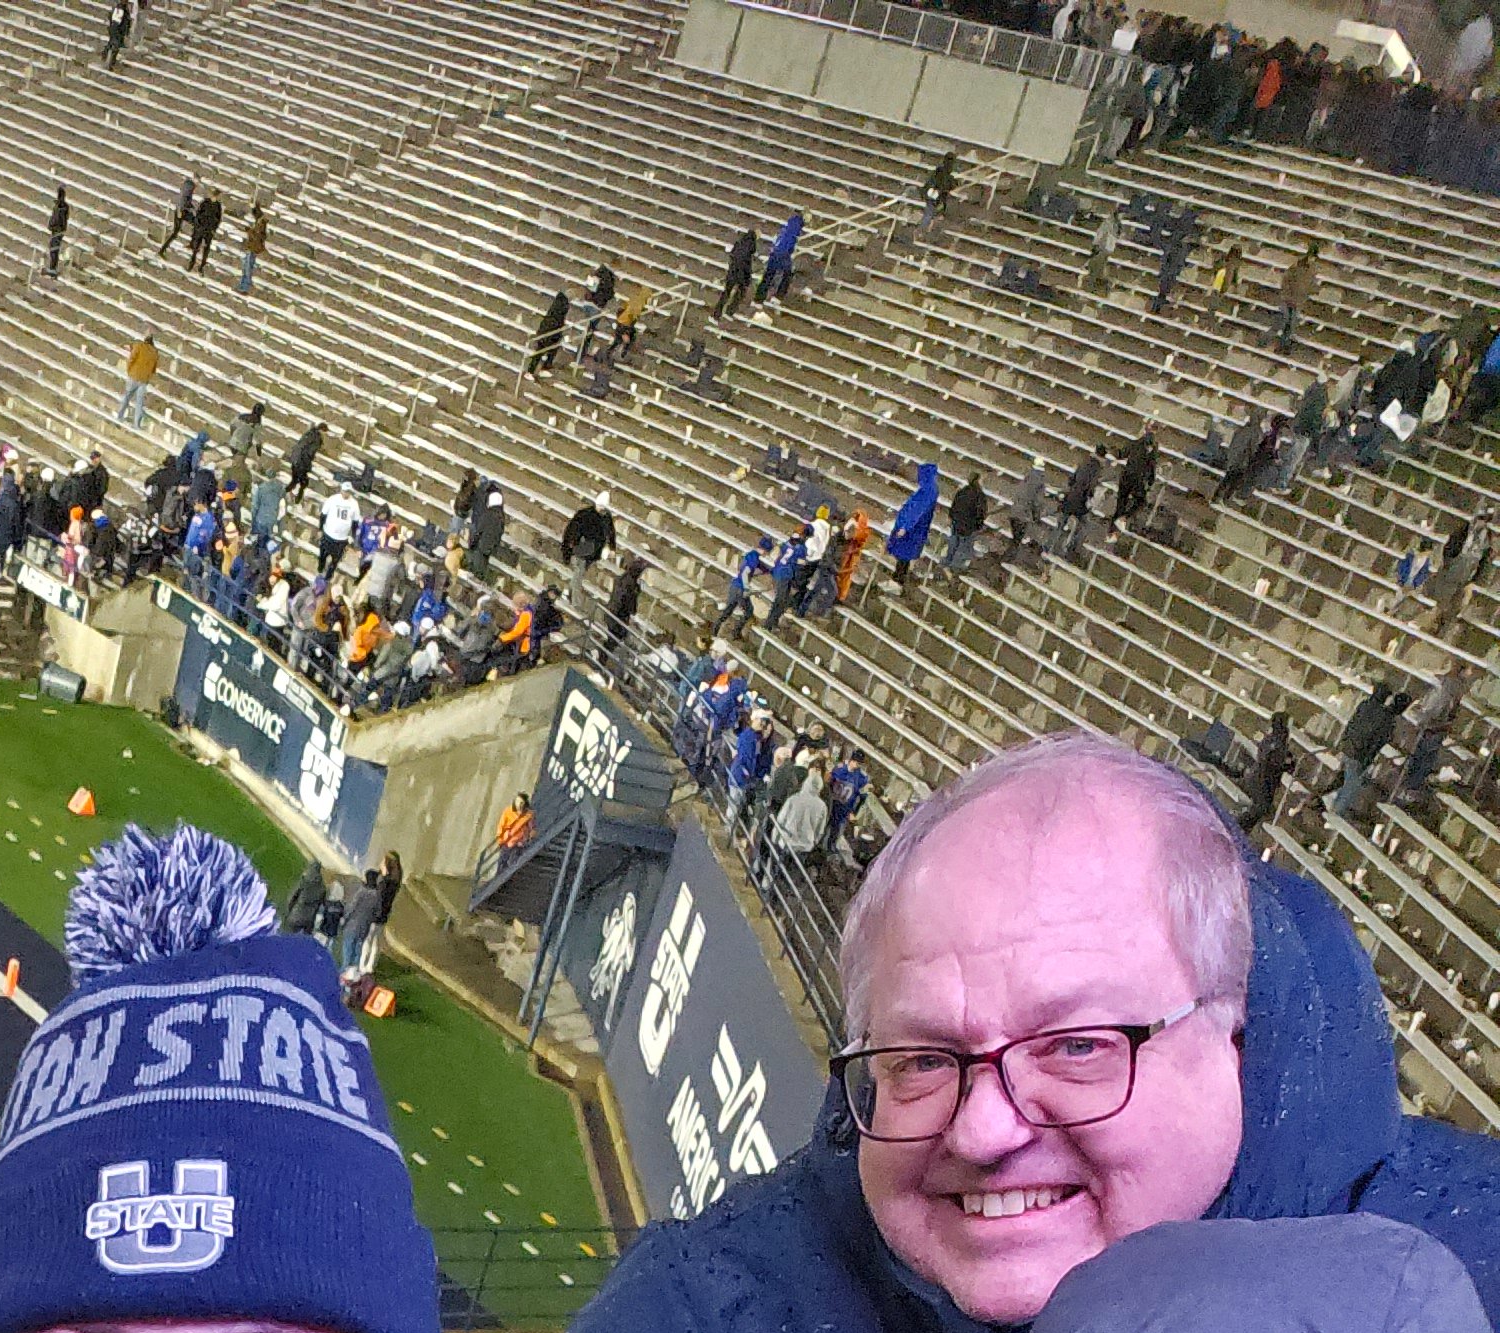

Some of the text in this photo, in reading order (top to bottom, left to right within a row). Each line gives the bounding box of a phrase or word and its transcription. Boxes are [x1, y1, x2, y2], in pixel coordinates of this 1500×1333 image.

[216, 676, 287, 745] CONSERVICE
[0, 996, 370, 1143] TAH STATE
[85, 1195, 236, 1240] STATE
